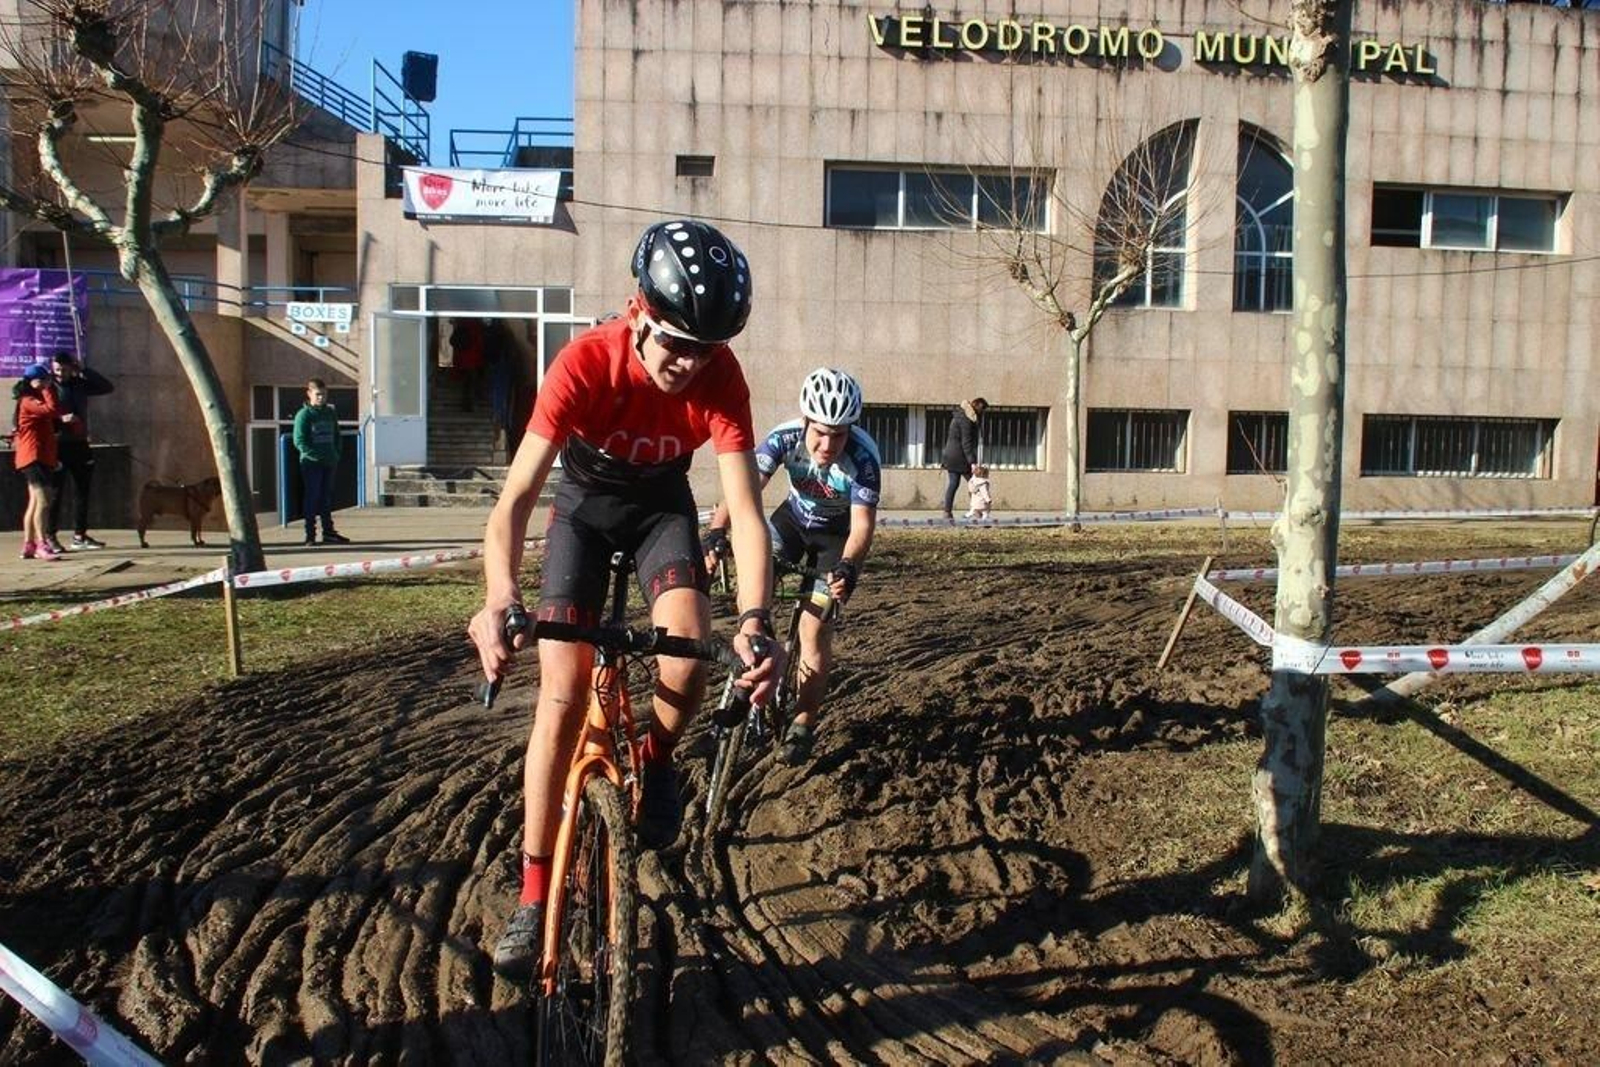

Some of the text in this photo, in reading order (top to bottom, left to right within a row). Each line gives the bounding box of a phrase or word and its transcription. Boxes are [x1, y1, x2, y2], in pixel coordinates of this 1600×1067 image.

[867, 12, 1435, 74] VELODROMO MUNPAL
[290, 305, 347, 319] BOXES
